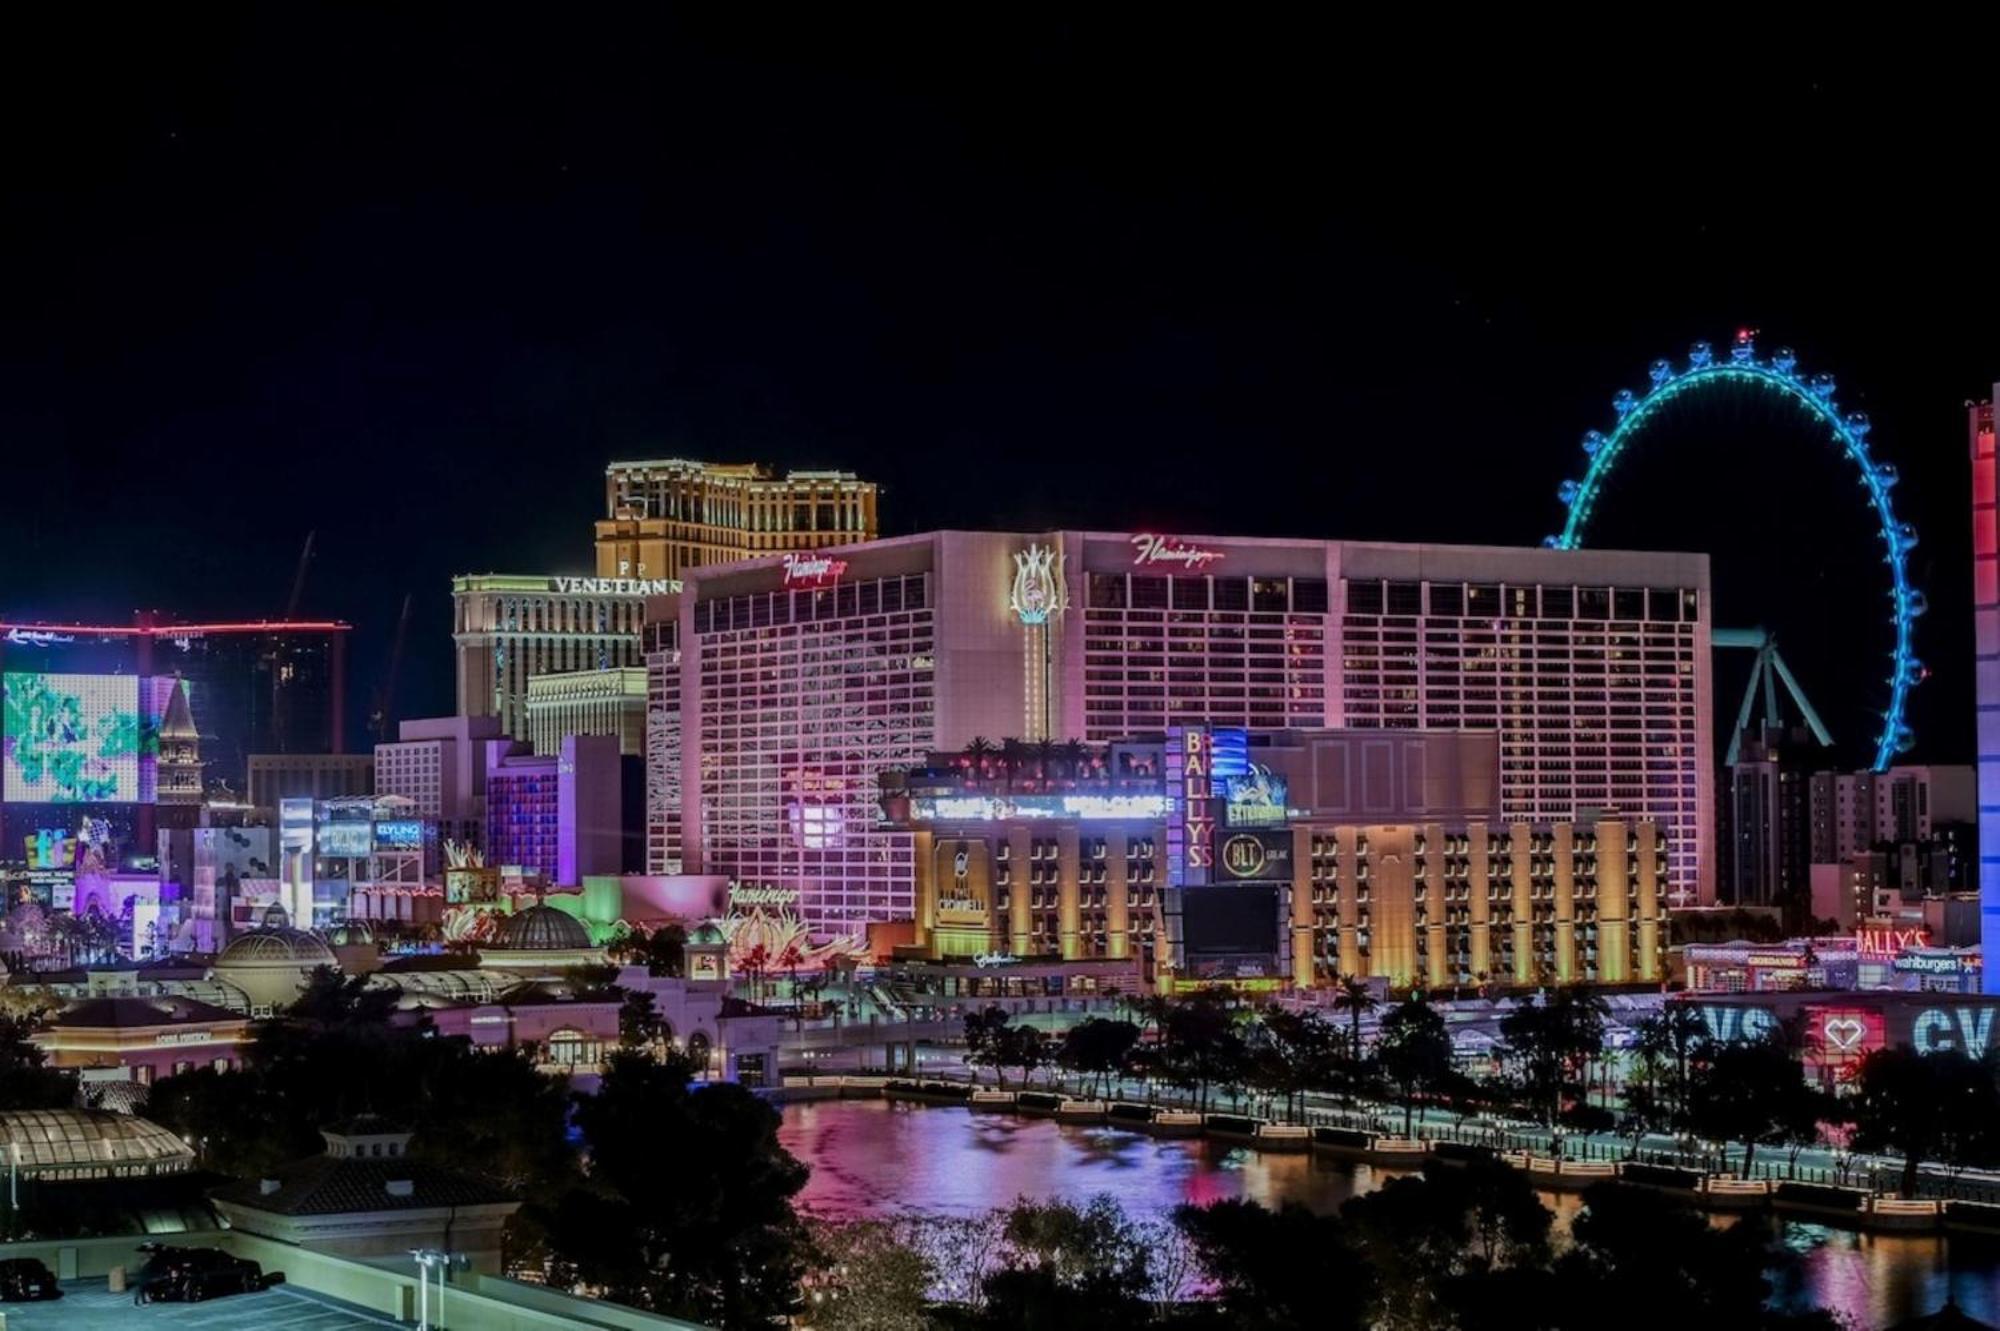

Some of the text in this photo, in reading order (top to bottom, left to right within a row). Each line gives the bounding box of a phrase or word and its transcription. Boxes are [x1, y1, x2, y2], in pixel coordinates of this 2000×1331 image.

[1131, 534, 1224, 568] Flamingo
[1231, 842, 1255, 868] BLT
[1895, 955, 1957, 973] wahlburgers
